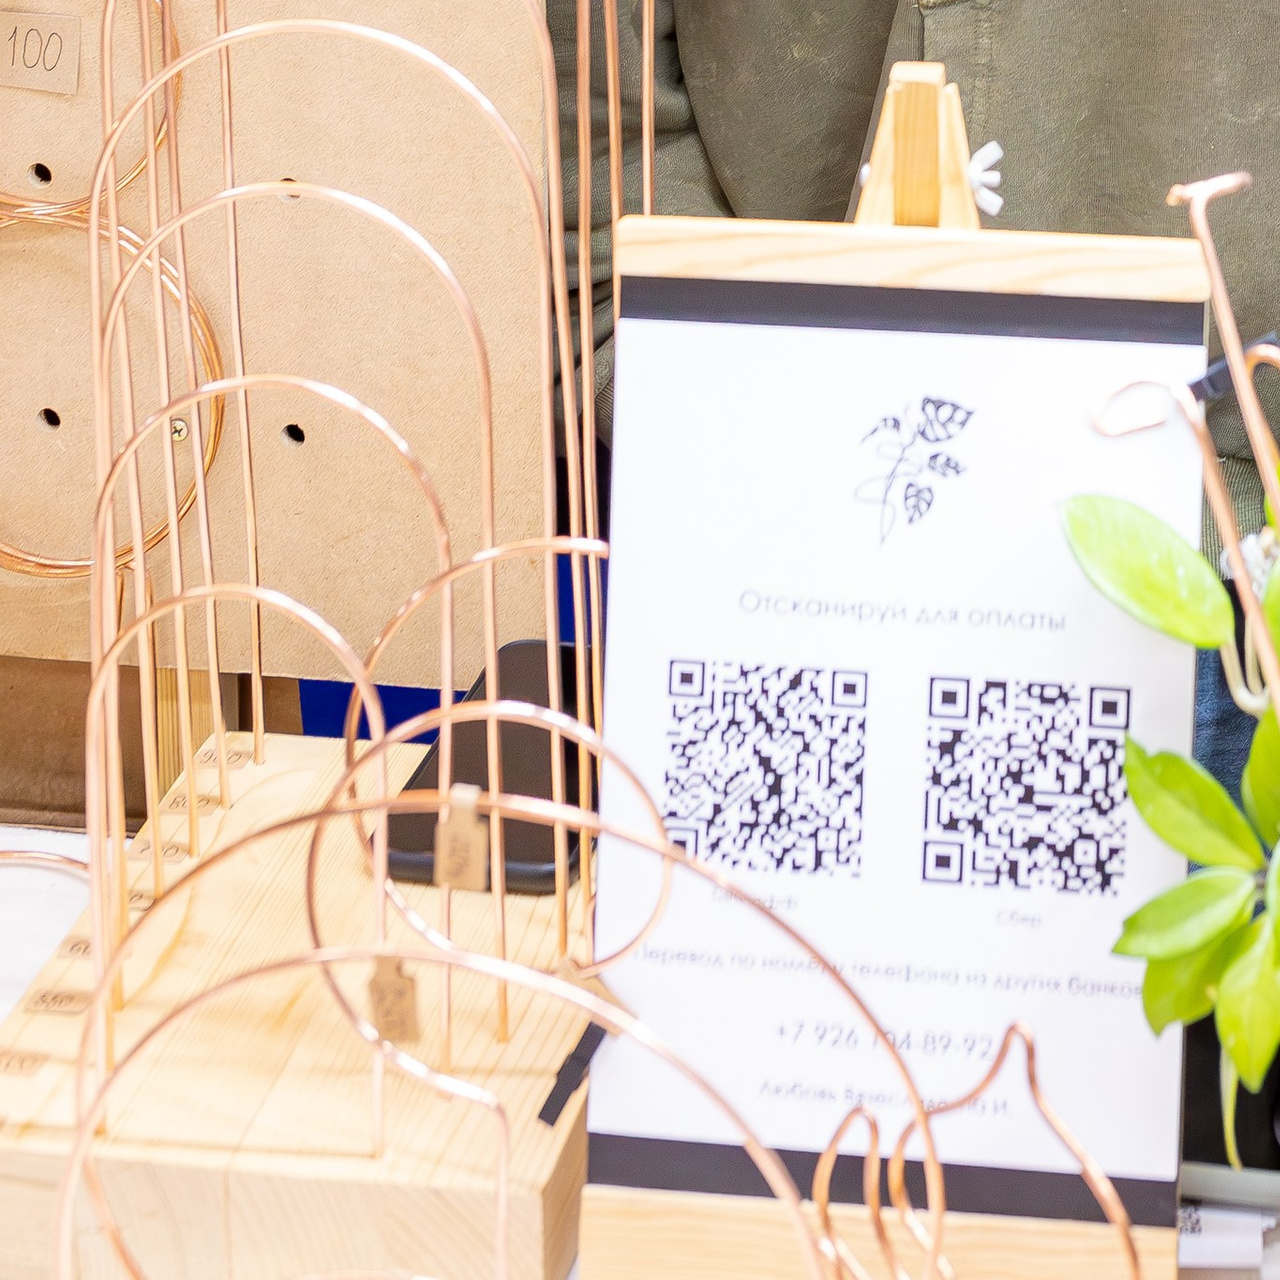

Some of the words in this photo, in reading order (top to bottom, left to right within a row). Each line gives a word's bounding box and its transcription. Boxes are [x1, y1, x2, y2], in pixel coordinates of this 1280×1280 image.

[8, 26, 62, 71] 100
[738, 588, 907, 626] Отсканируй
[915, 604, 960, 626] для
[967, 607, 1067, 633] оплаты
[774, 1020, 805, 1046] +7
[814, 1023, 859, 1051] 926
